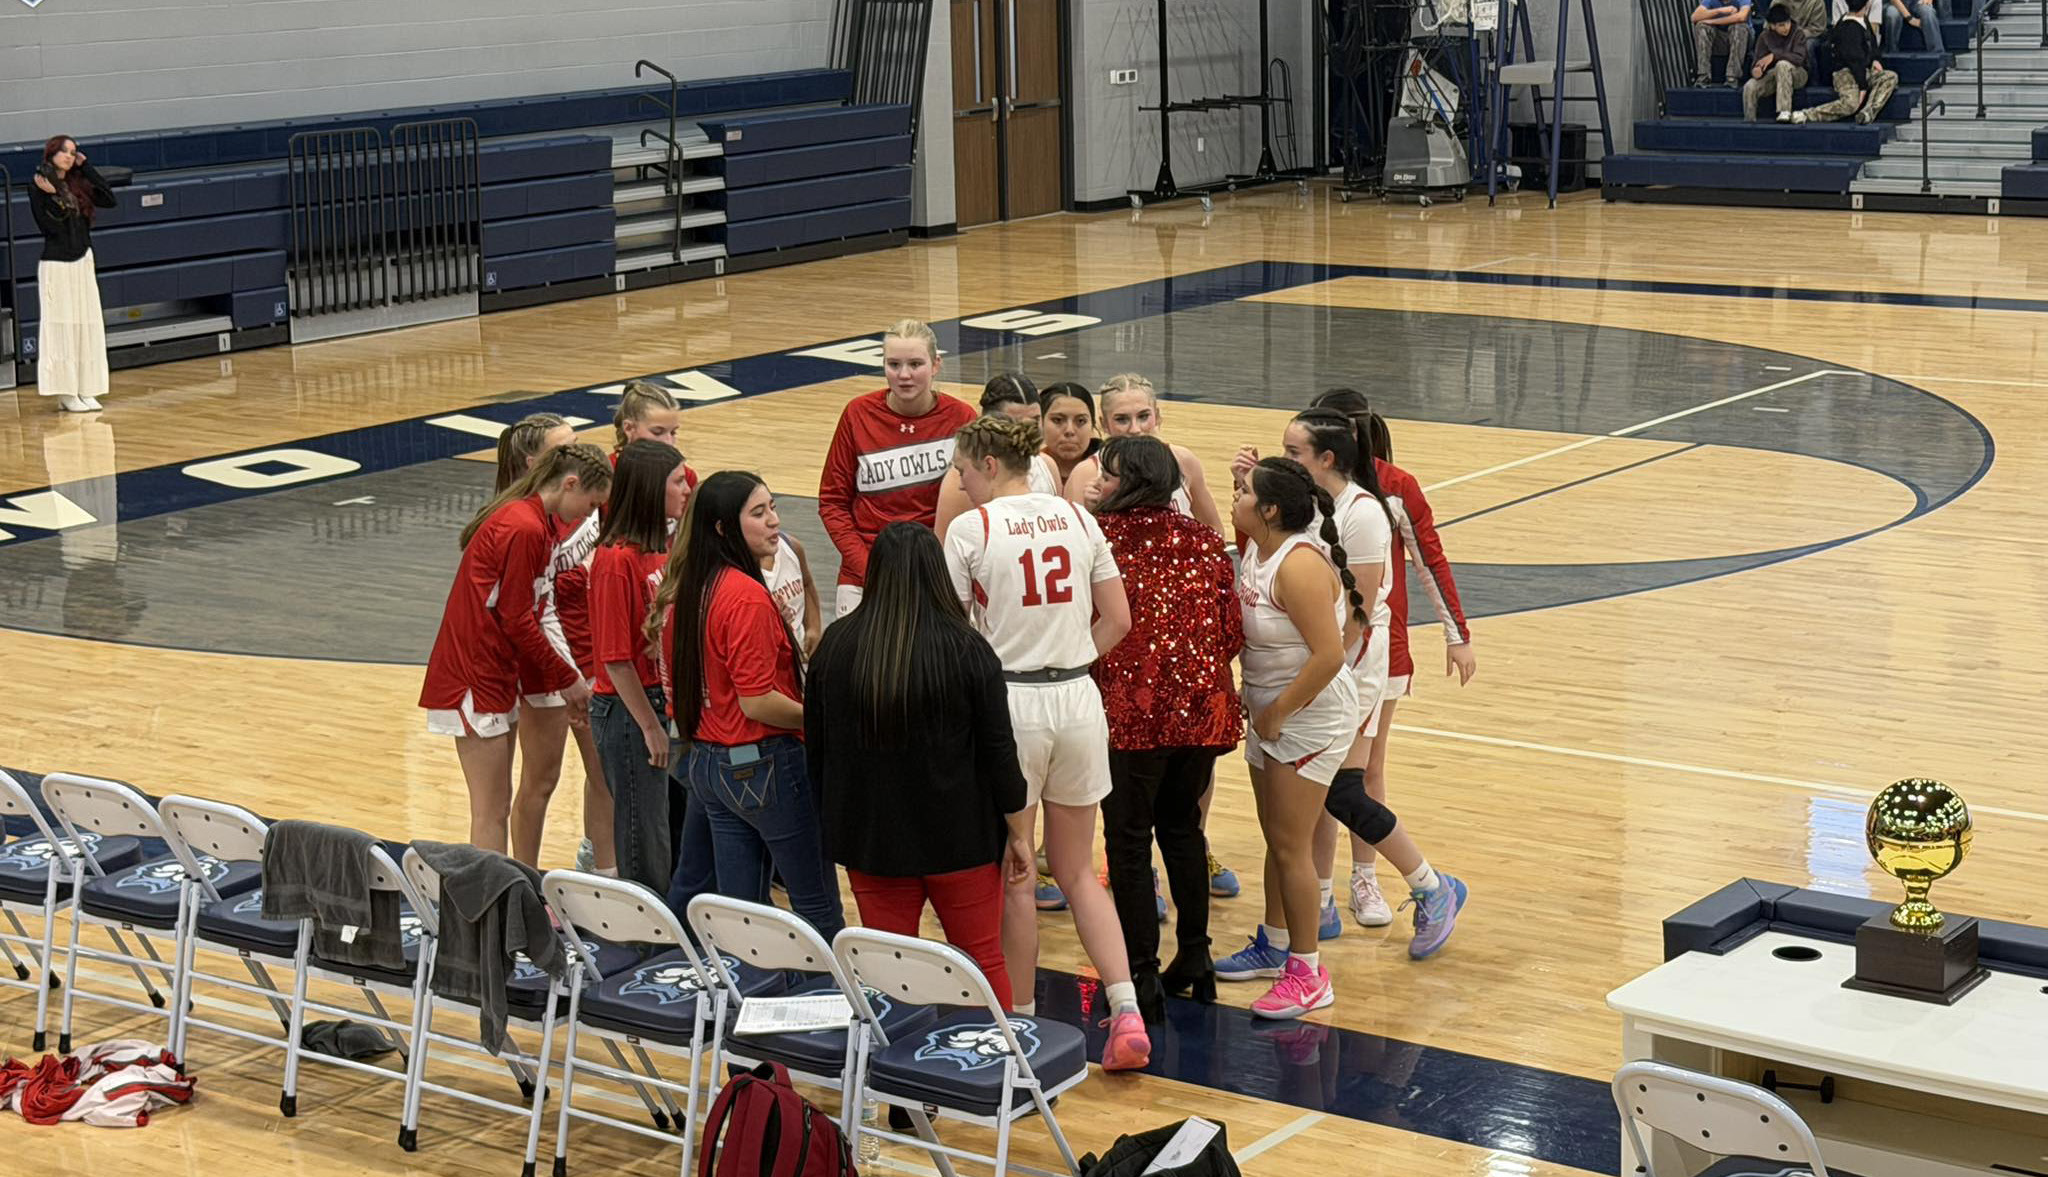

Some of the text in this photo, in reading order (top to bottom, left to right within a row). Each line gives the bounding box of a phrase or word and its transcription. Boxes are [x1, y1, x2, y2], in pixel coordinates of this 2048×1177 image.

[899, 449, 948, 478] OWLS
[1004, 513, 1069, 539] Lady Owls
[1018, 545, 1073, 607] 12
